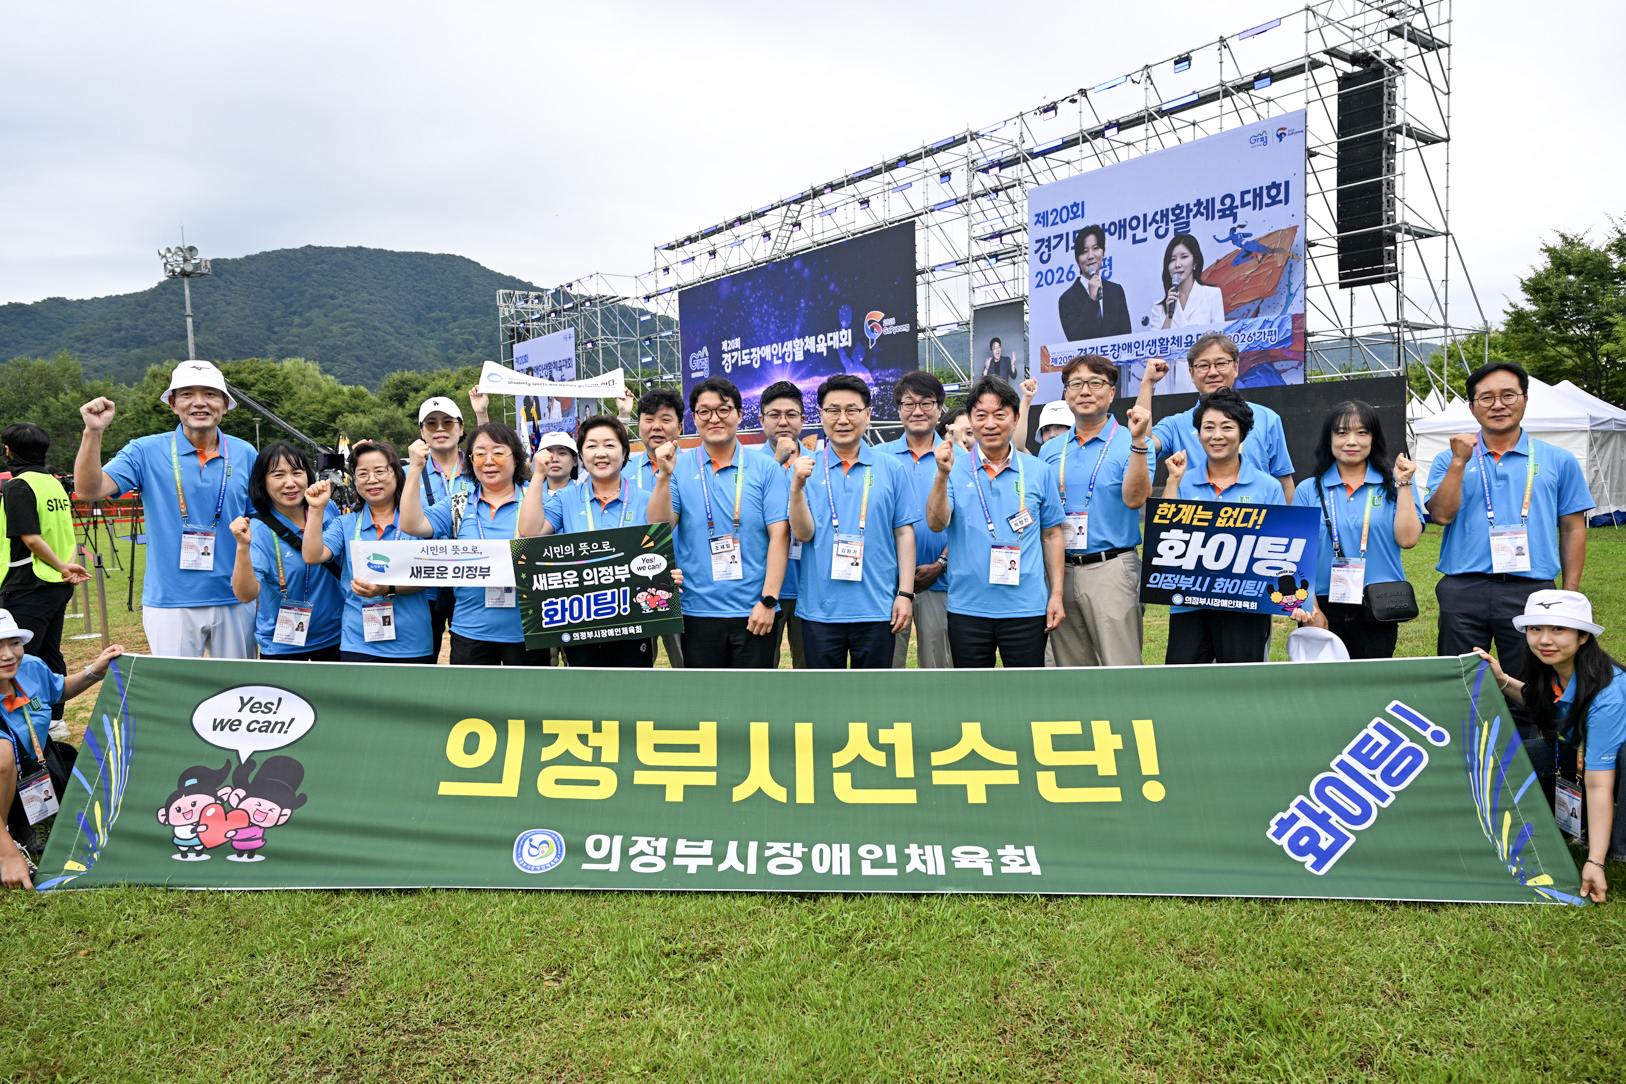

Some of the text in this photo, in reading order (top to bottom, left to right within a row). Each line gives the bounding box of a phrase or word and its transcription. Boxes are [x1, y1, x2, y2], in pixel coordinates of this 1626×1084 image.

[1034, 201, 1085, 228] 제20회
[1034, 180, 1290, 265] 경기애인생활체육대회
[1035, 264, 1076, 289] 2026
[721, 337, 741, 351] 제20회
[1256, 329, 1277, 344] 가평
[721, 329, 852, 373] 경기도장애인생활체육대회
[47, 499, 69, 512] STAF
[1152, 503, 1267, 529] 한계는 없다!
[420, 545, 483, 556] 시민의 뜻으로,
[542, 541, 616, 559] 시민의 뜻으로,
[1151, 529, 1307, 577] 화이팅
[641, 556, 656, 564] Yes!
[648, 563, 662, 571] can!
[409, 566, 491, 579] 새로운 의정부
[532, 564, 631, 591] 새로운 의정부
[1146, 572, 1211, 591] 의정부시
[543, 587, 630, 627] 화이팅!
[1184, 596, 1257, 609] 의정부시장애인체육회
[572, 625, 643, 641] 의정부시장애인체육회
[237, 696, 283, 715] Yes!
[212, 717, 296, 734] we can!
[437, 718, 1166, 804] 의정부시선수단!
[1268, 701, 1449, 874] 화이팅!
[581, 834, 1042, 876] 의정부시장애인체육회
